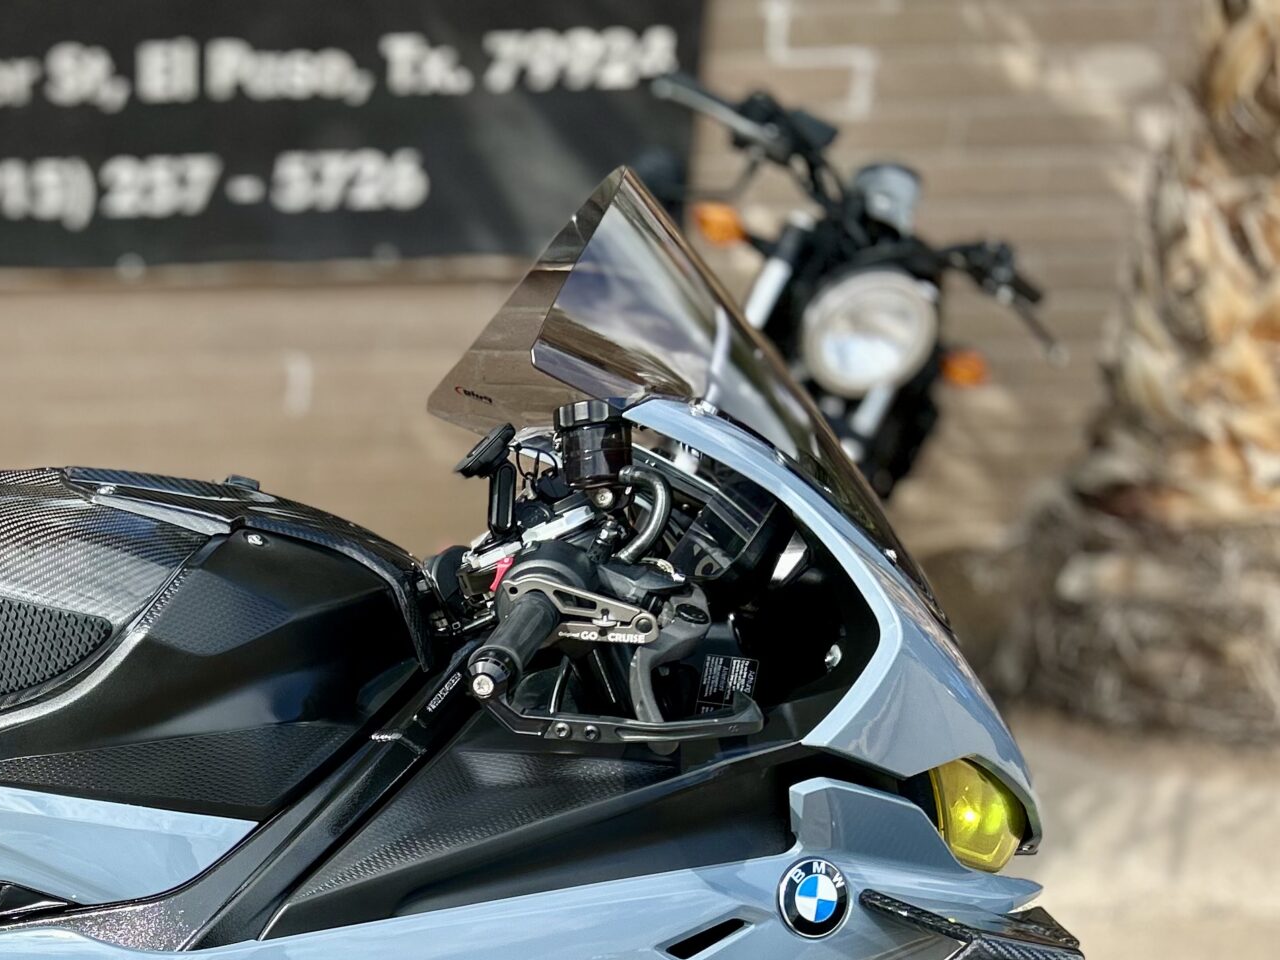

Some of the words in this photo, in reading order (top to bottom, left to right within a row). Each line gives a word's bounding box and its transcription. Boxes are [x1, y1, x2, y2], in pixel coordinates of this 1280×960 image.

[135, 37, 199, 101] El
[204, 38, 375, 105] Paso,
[580, 631, 598, 641] GO
[607, 632, 646, 643] CRUISE
[790, 862, 845, 888] BMW
